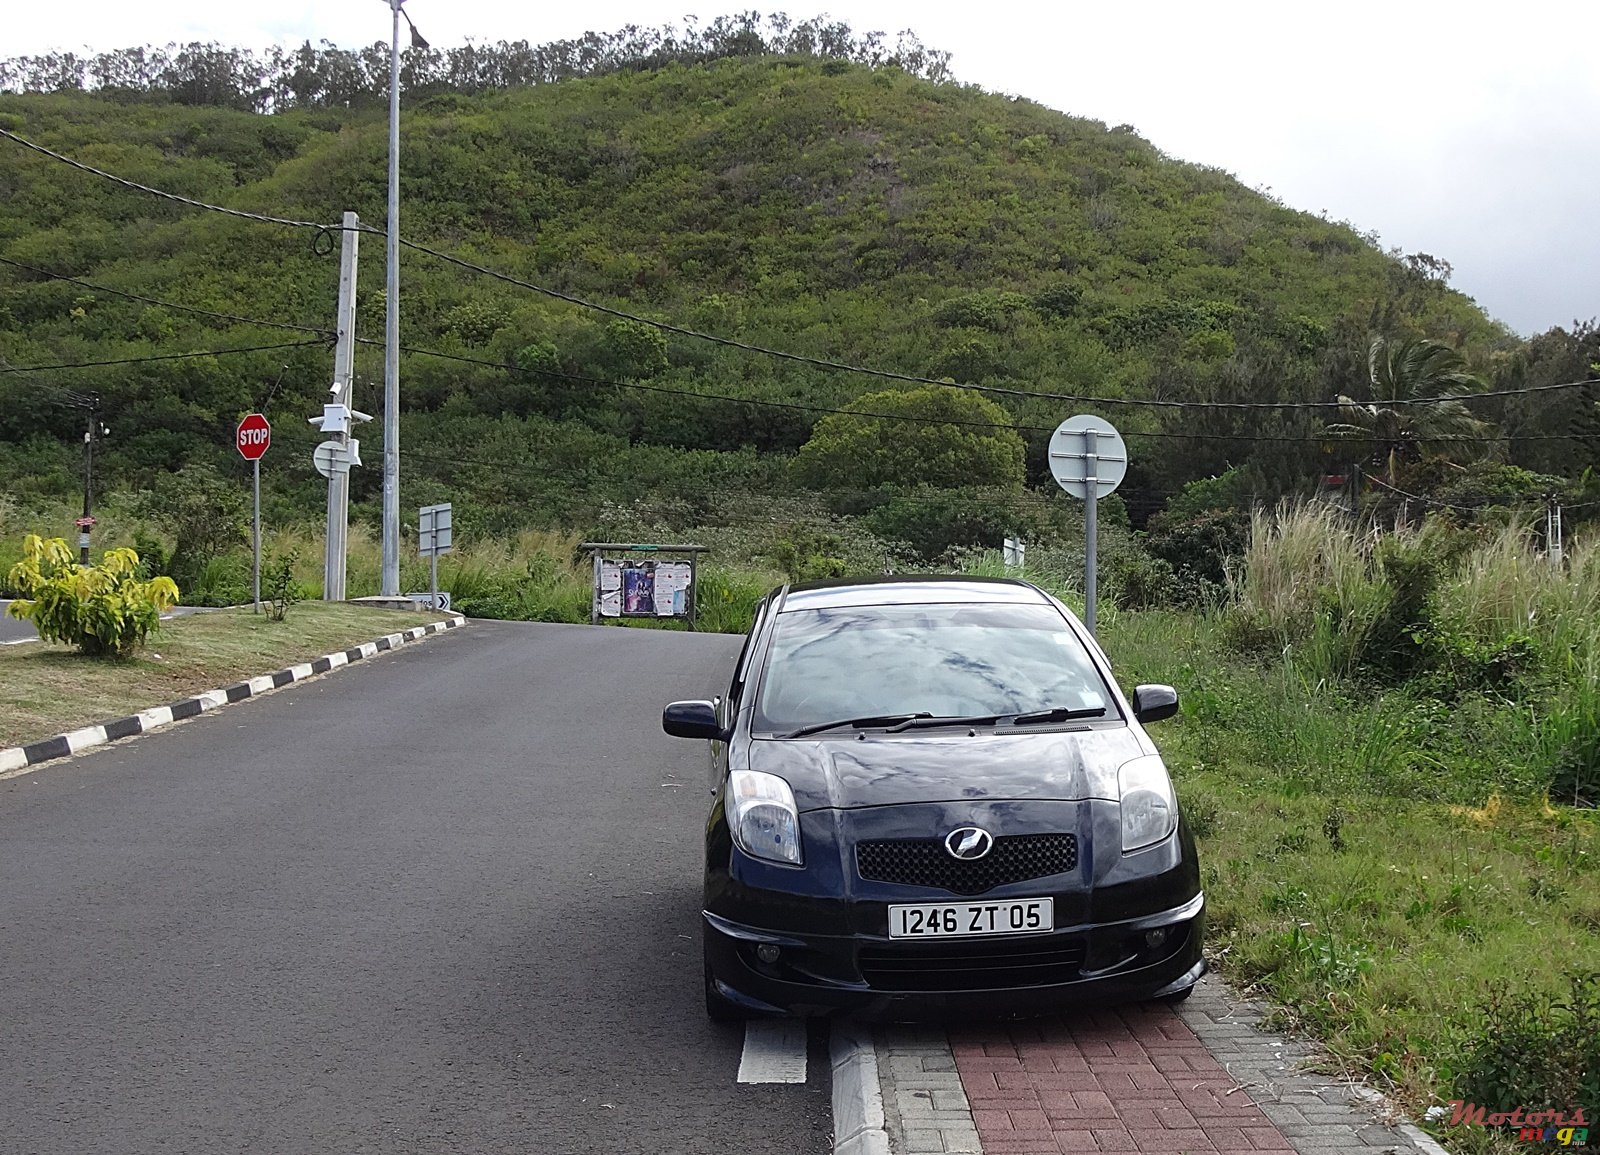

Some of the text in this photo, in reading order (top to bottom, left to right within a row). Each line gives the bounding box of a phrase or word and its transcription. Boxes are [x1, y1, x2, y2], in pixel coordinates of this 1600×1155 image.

[240, 428, 268, 446] STOP
[902, 904, 1040, 934] 1246 ZT 05
